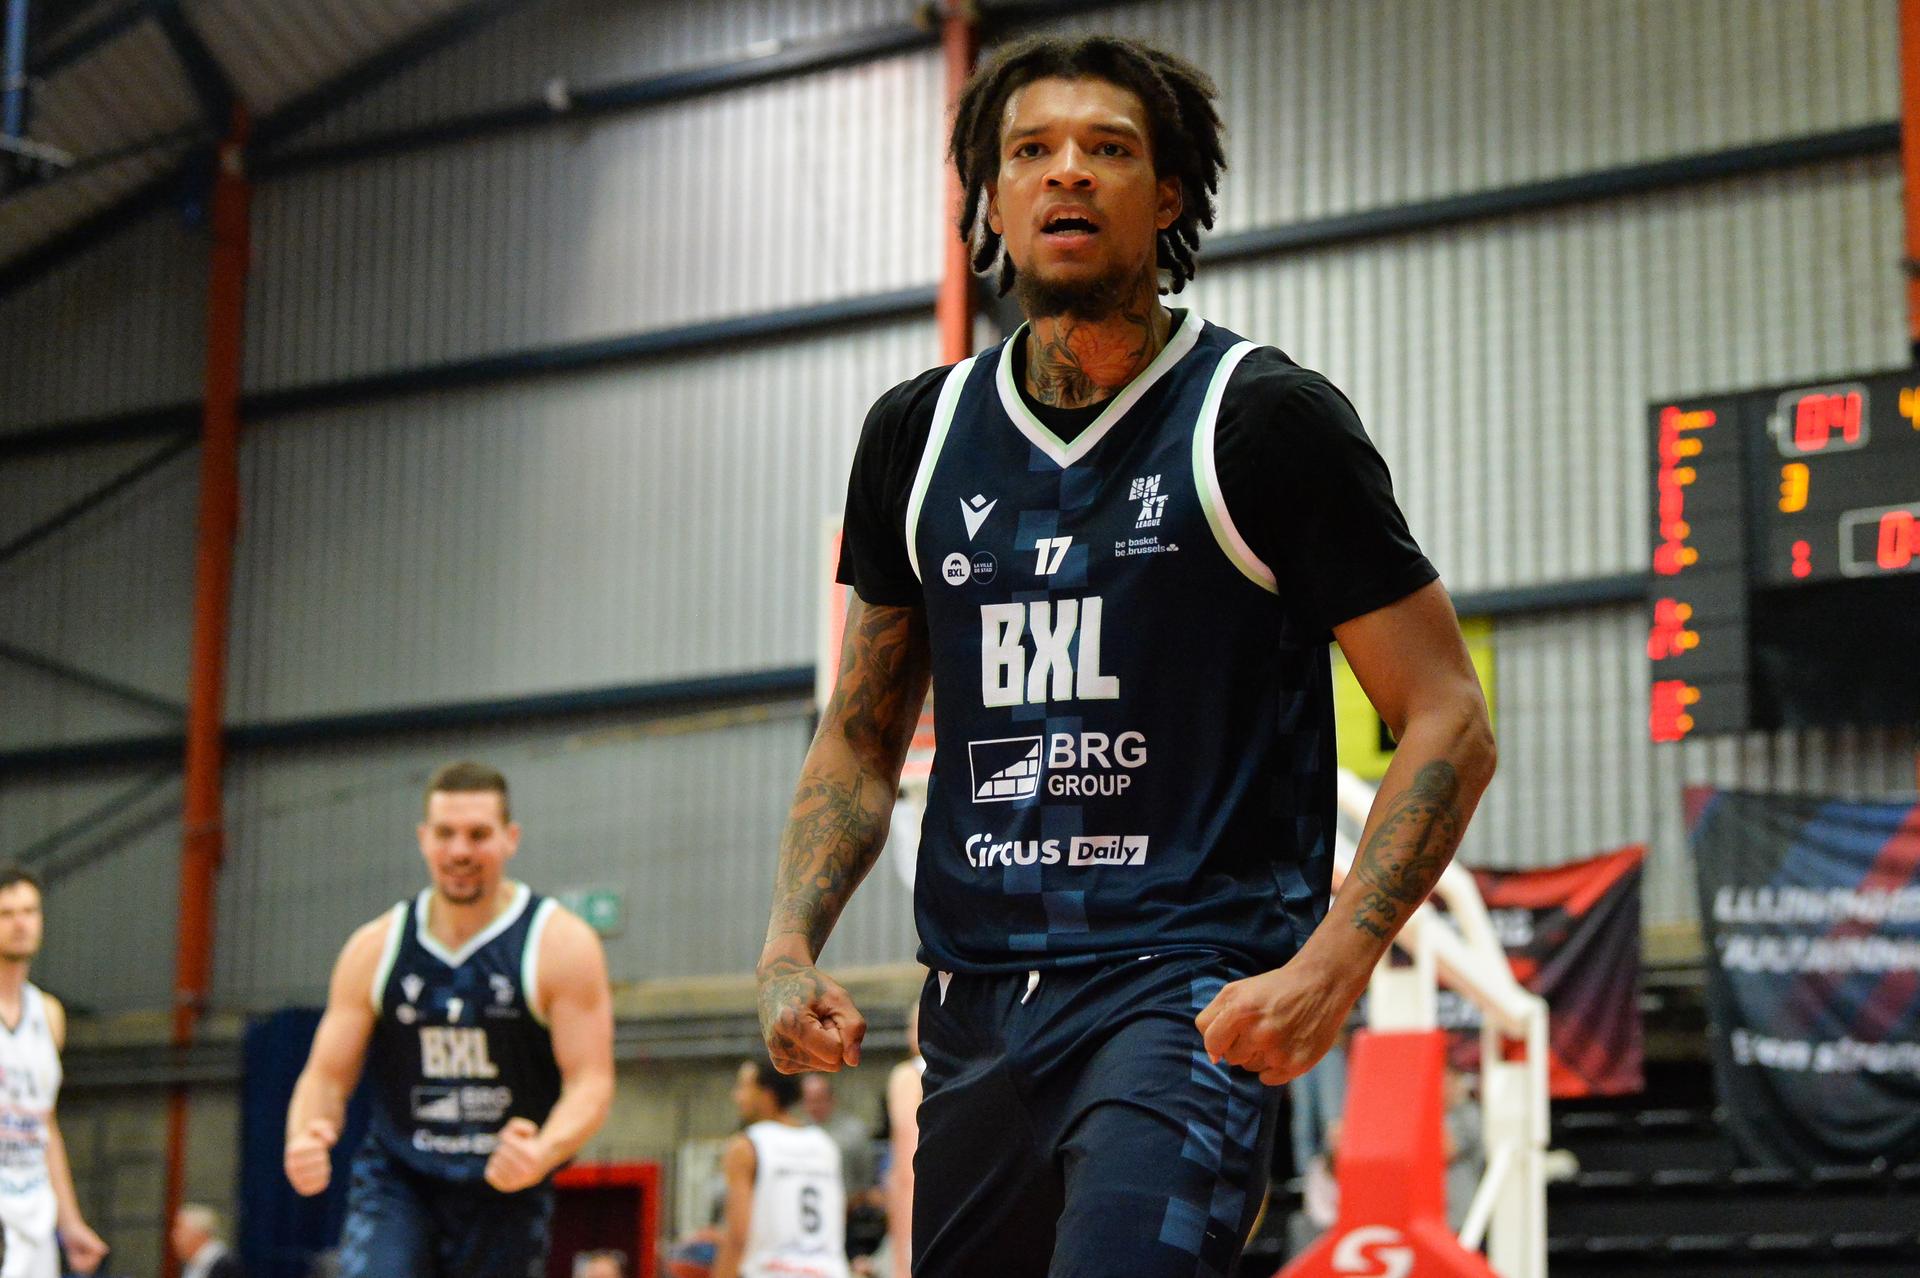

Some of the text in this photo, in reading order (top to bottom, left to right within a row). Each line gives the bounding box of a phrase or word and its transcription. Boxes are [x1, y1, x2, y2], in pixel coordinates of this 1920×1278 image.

[1135, 518, 1161, 529] LEAGUE
[1876, 510, 1920, 569] 0
[1034, 536, 1073, 575] 17
[1115, 536, 1158, 549] be basket
[947, 568, 965, 577] BXL
[980, 596, 1120, 708] BXL
[1048, 731, 1147, 769] BRG
[1048, 775, 1131, 796] GROUP
[965, 833, 1139, 868] Circus Daily
[419, 1026, 499, 1079] BXL
